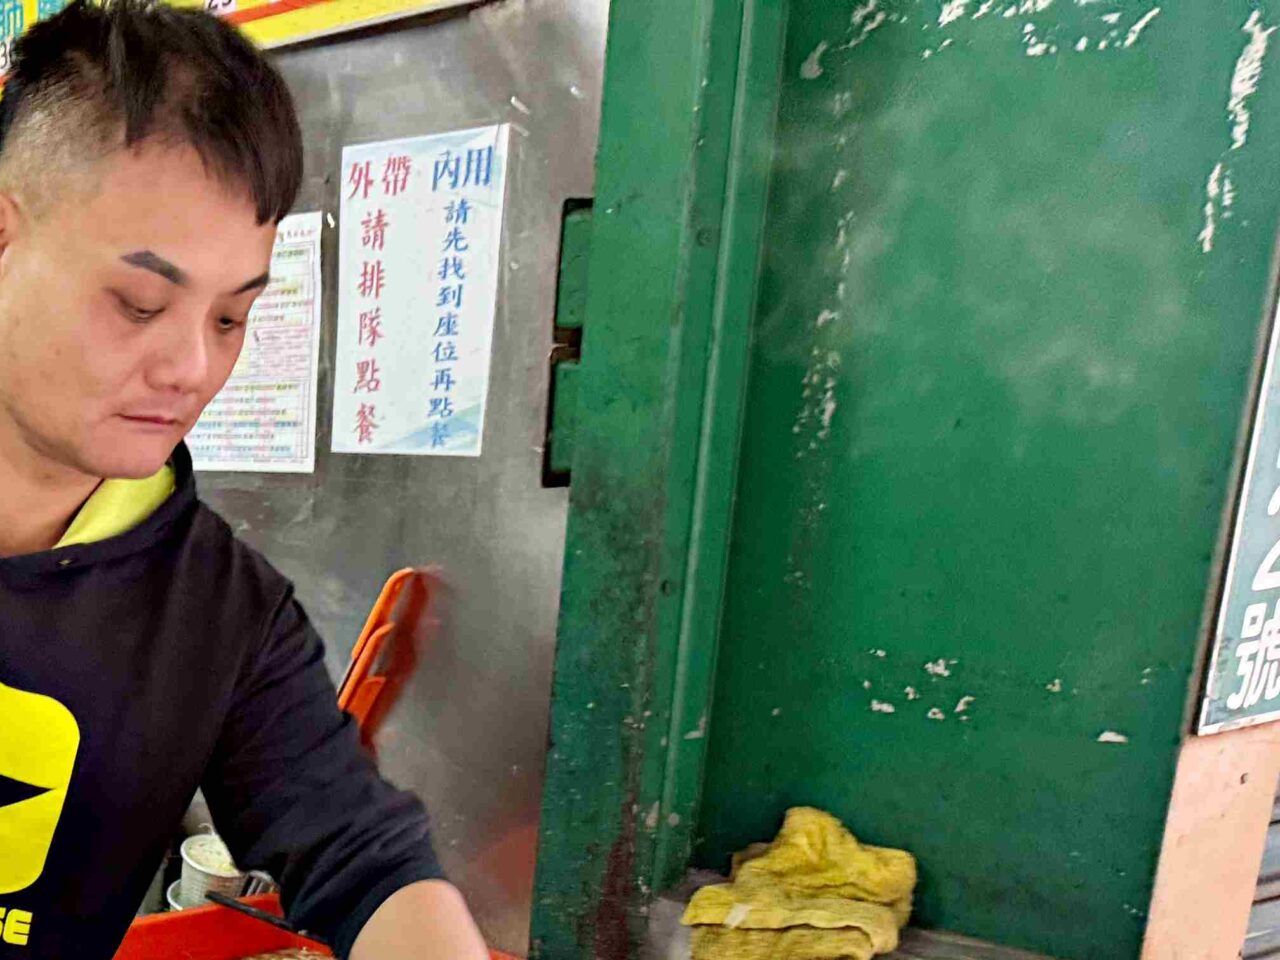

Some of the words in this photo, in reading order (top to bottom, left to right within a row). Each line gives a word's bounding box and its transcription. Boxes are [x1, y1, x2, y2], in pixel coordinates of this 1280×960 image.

[347, 155, 412, 200] 外帶
[353, 208, 390, 445] 請排隊點餐
